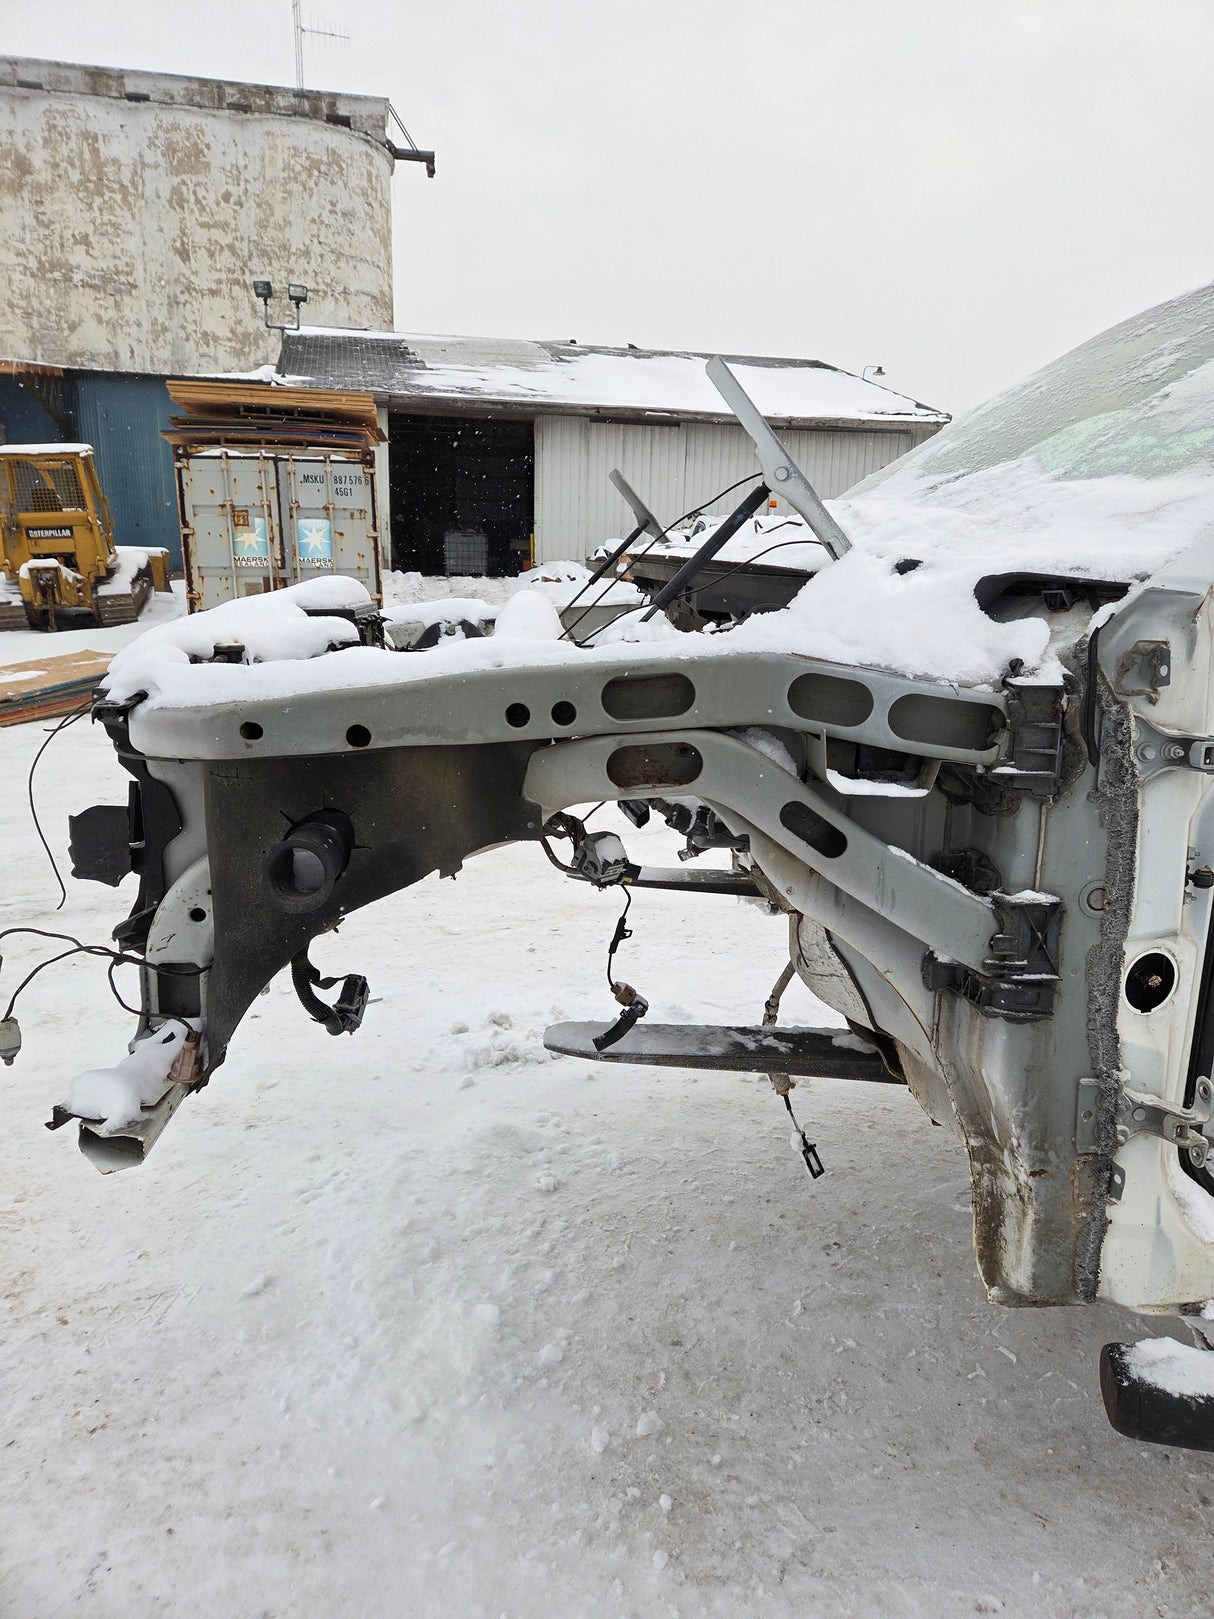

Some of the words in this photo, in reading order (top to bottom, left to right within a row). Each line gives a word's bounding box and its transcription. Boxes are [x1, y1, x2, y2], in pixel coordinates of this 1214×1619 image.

[303, 474, 325, 484] MSKU
[335, 487, 353, 497] 45G1
[28, 529, 71, 537] CATERPILLAR
